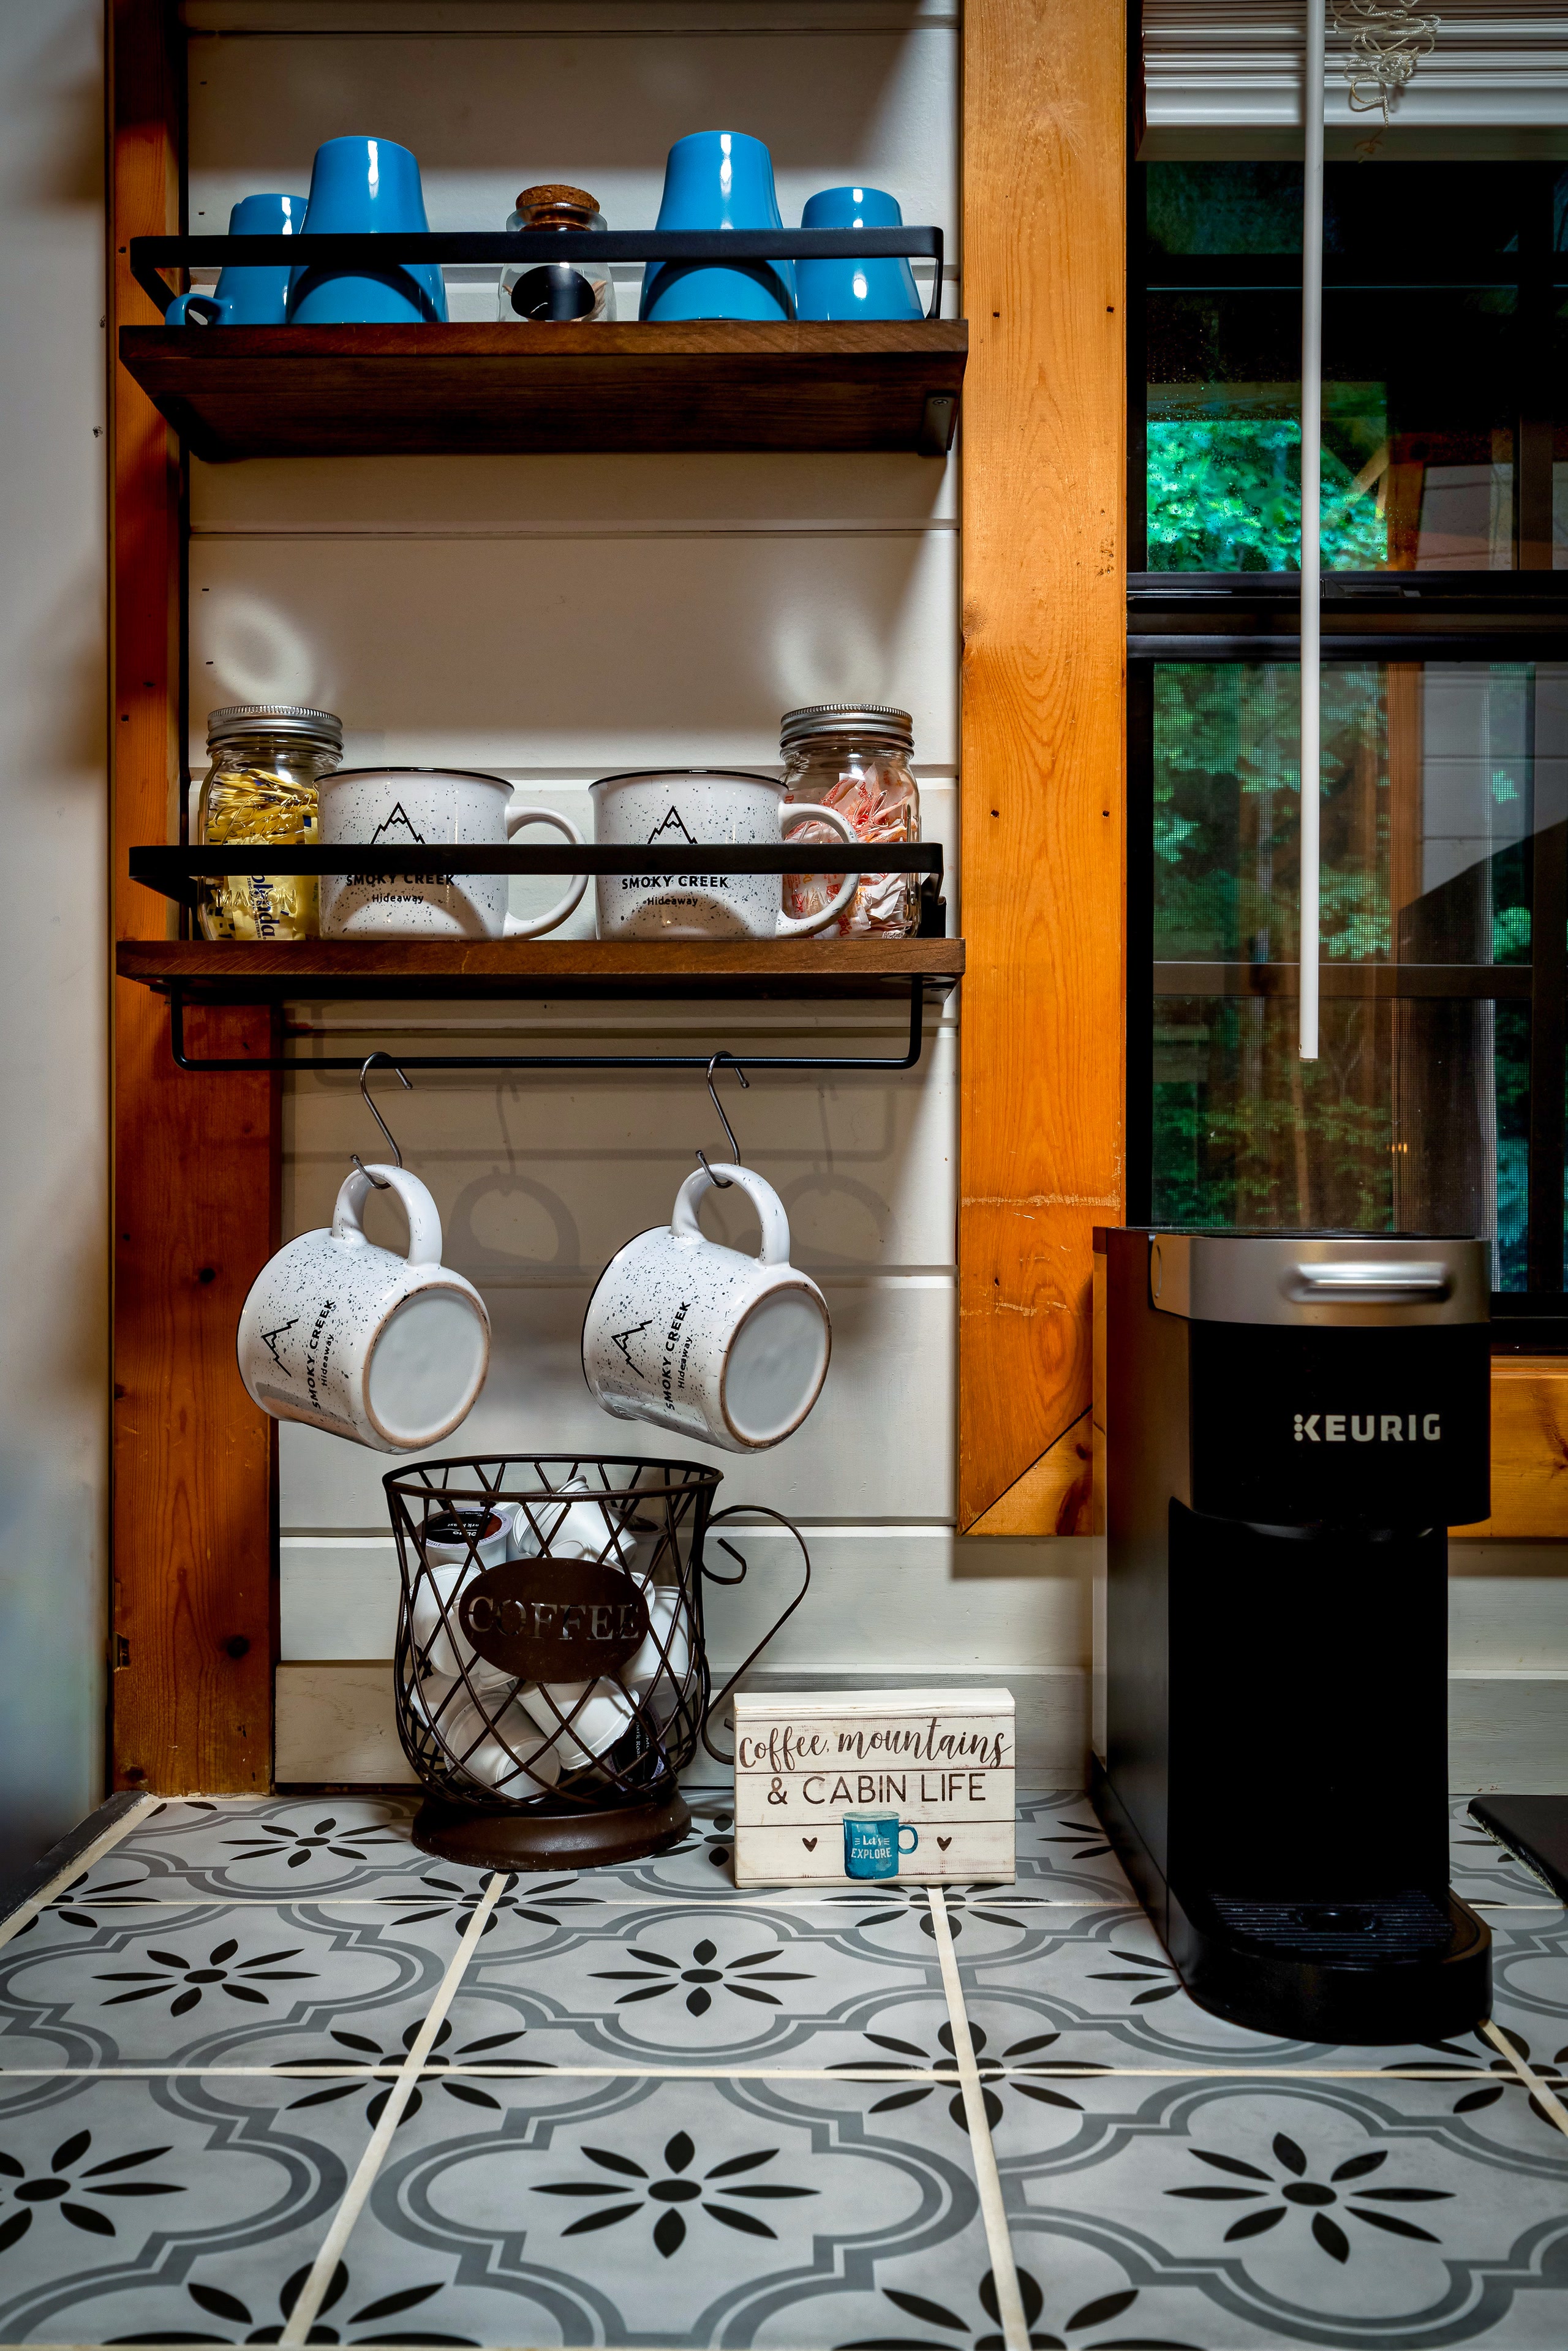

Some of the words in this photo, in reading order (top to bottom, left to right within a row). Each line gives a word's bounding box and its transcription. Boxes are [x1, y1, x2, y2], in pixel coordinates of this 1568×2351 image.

[215, 888, 296, 907] MASON
[346, 875, 397, 886] SMOKY
[404, 875, 454, 886] CREEK
[372, 894, 424, 904] Hideaway
[622, 875, 672, 889] SMOKY
[679, 875, 729, 888] CREEK
[251, 875, 280, 937] plenda
[647, 896, 698, 907] Hideaway
[309, 1299, 336, 1349] CREEK
[667, 1301, 691, 1353] CREEK
[321, 1334, 334, 1387] Hideaway
[677, 1336, 693, 1389] Hideaway
[307, 1354, 321, 1409] SMOKY
[660, 1356, 675, 1410] SMOKY
[1294, 1413, 1441, 1442] KEURIG
[469, 1596, 639, 1640] COFFEE
[837, 1718, 1012, 1768] mountains
[767, 1777, 788, 1805] &
[803, 1775, 907, 1805] CABIN
[921, 1773, 986, 1802] LIFE
[851, 1847, 892, 1859] EXPLORE
[862, 1835, 883, 1846] Let's
